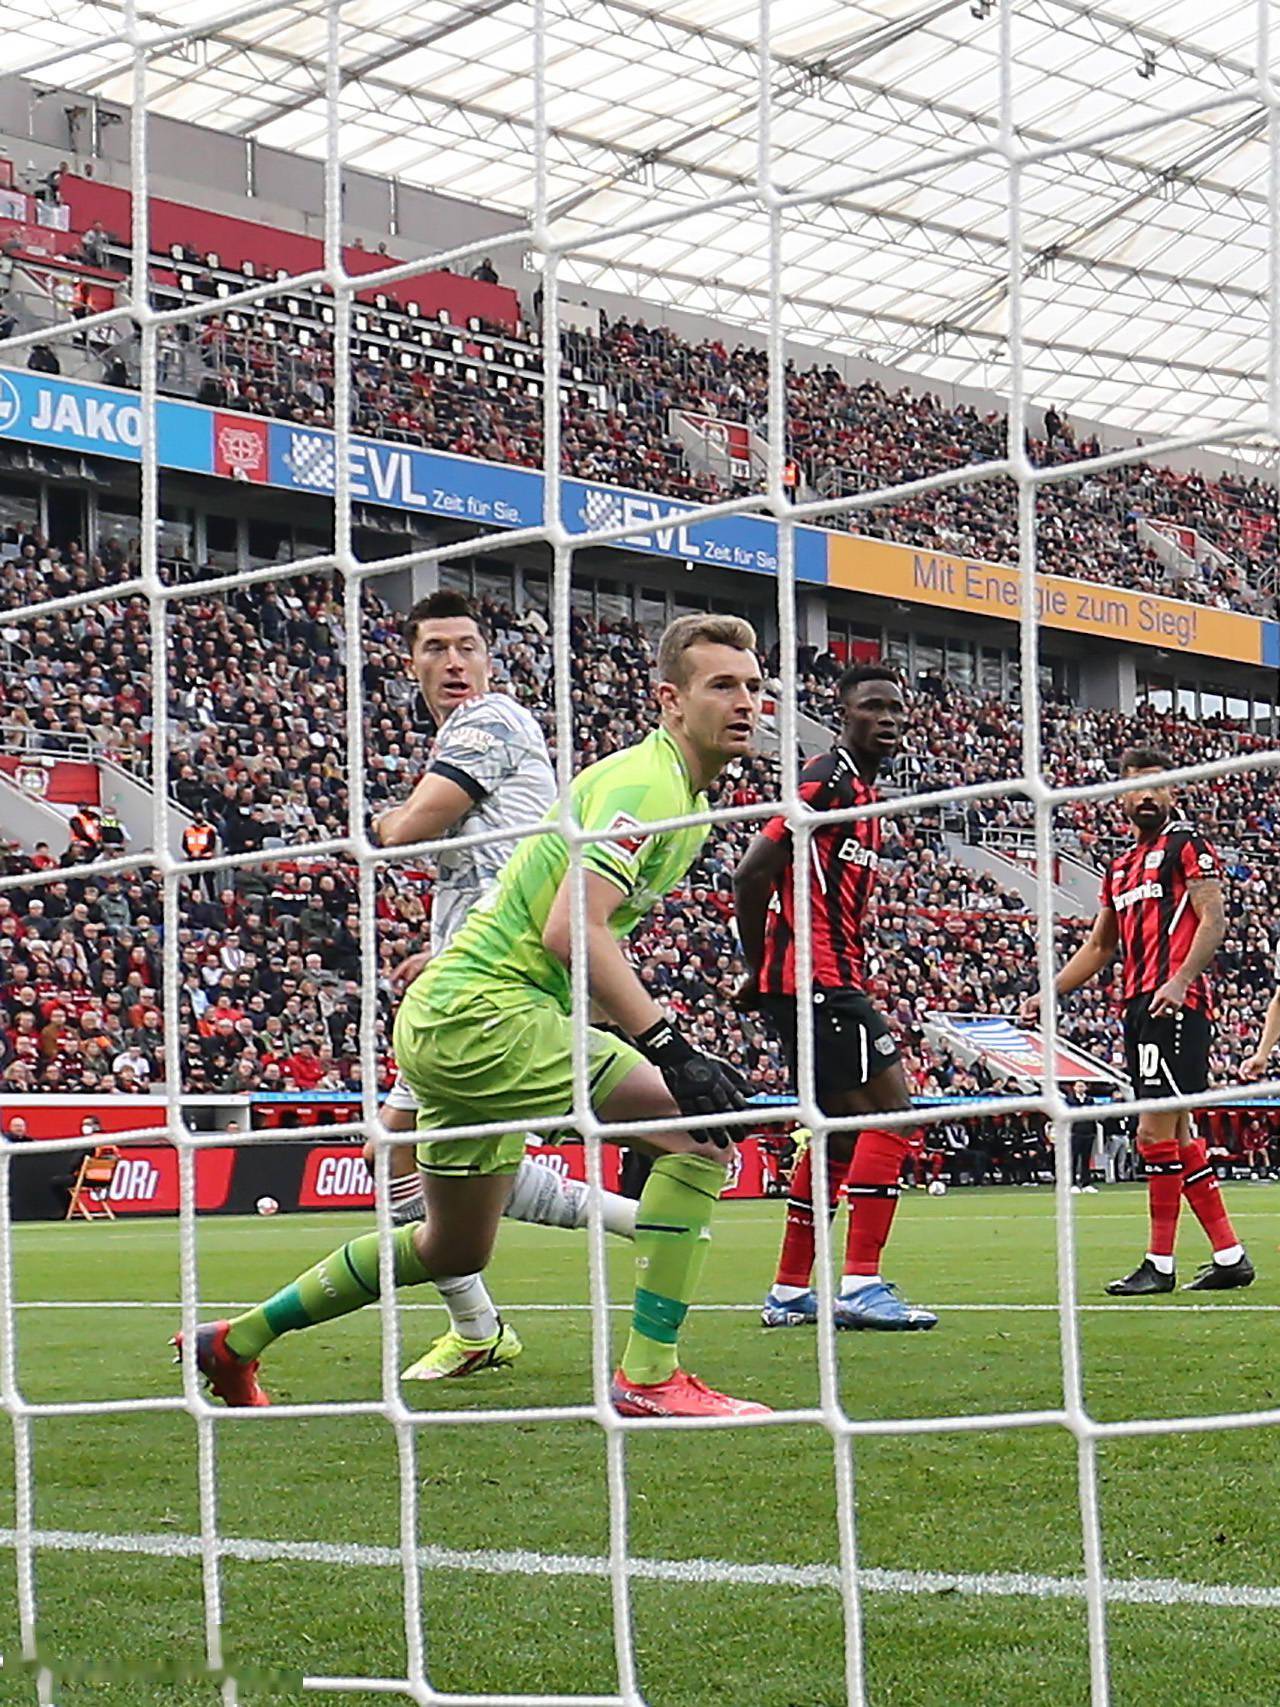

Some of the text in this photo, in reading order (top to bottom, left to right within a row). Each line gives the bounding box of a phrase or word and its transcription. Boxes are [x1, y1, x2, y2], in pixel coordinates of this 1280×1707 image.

[31, 389, 143, 447] JAKO
[345, 444, 427, 506] EVL
[432, 489, 465, 513] Zeit
[467, 497, 491, 516] für
[623, 497, 700, 556] EVL
[704, 540, 732, 561] Zeit
[913, 554, 1198, 646] Mit Enegie zum Sieg!
[1138, 1043, 1160, 1079] 10
